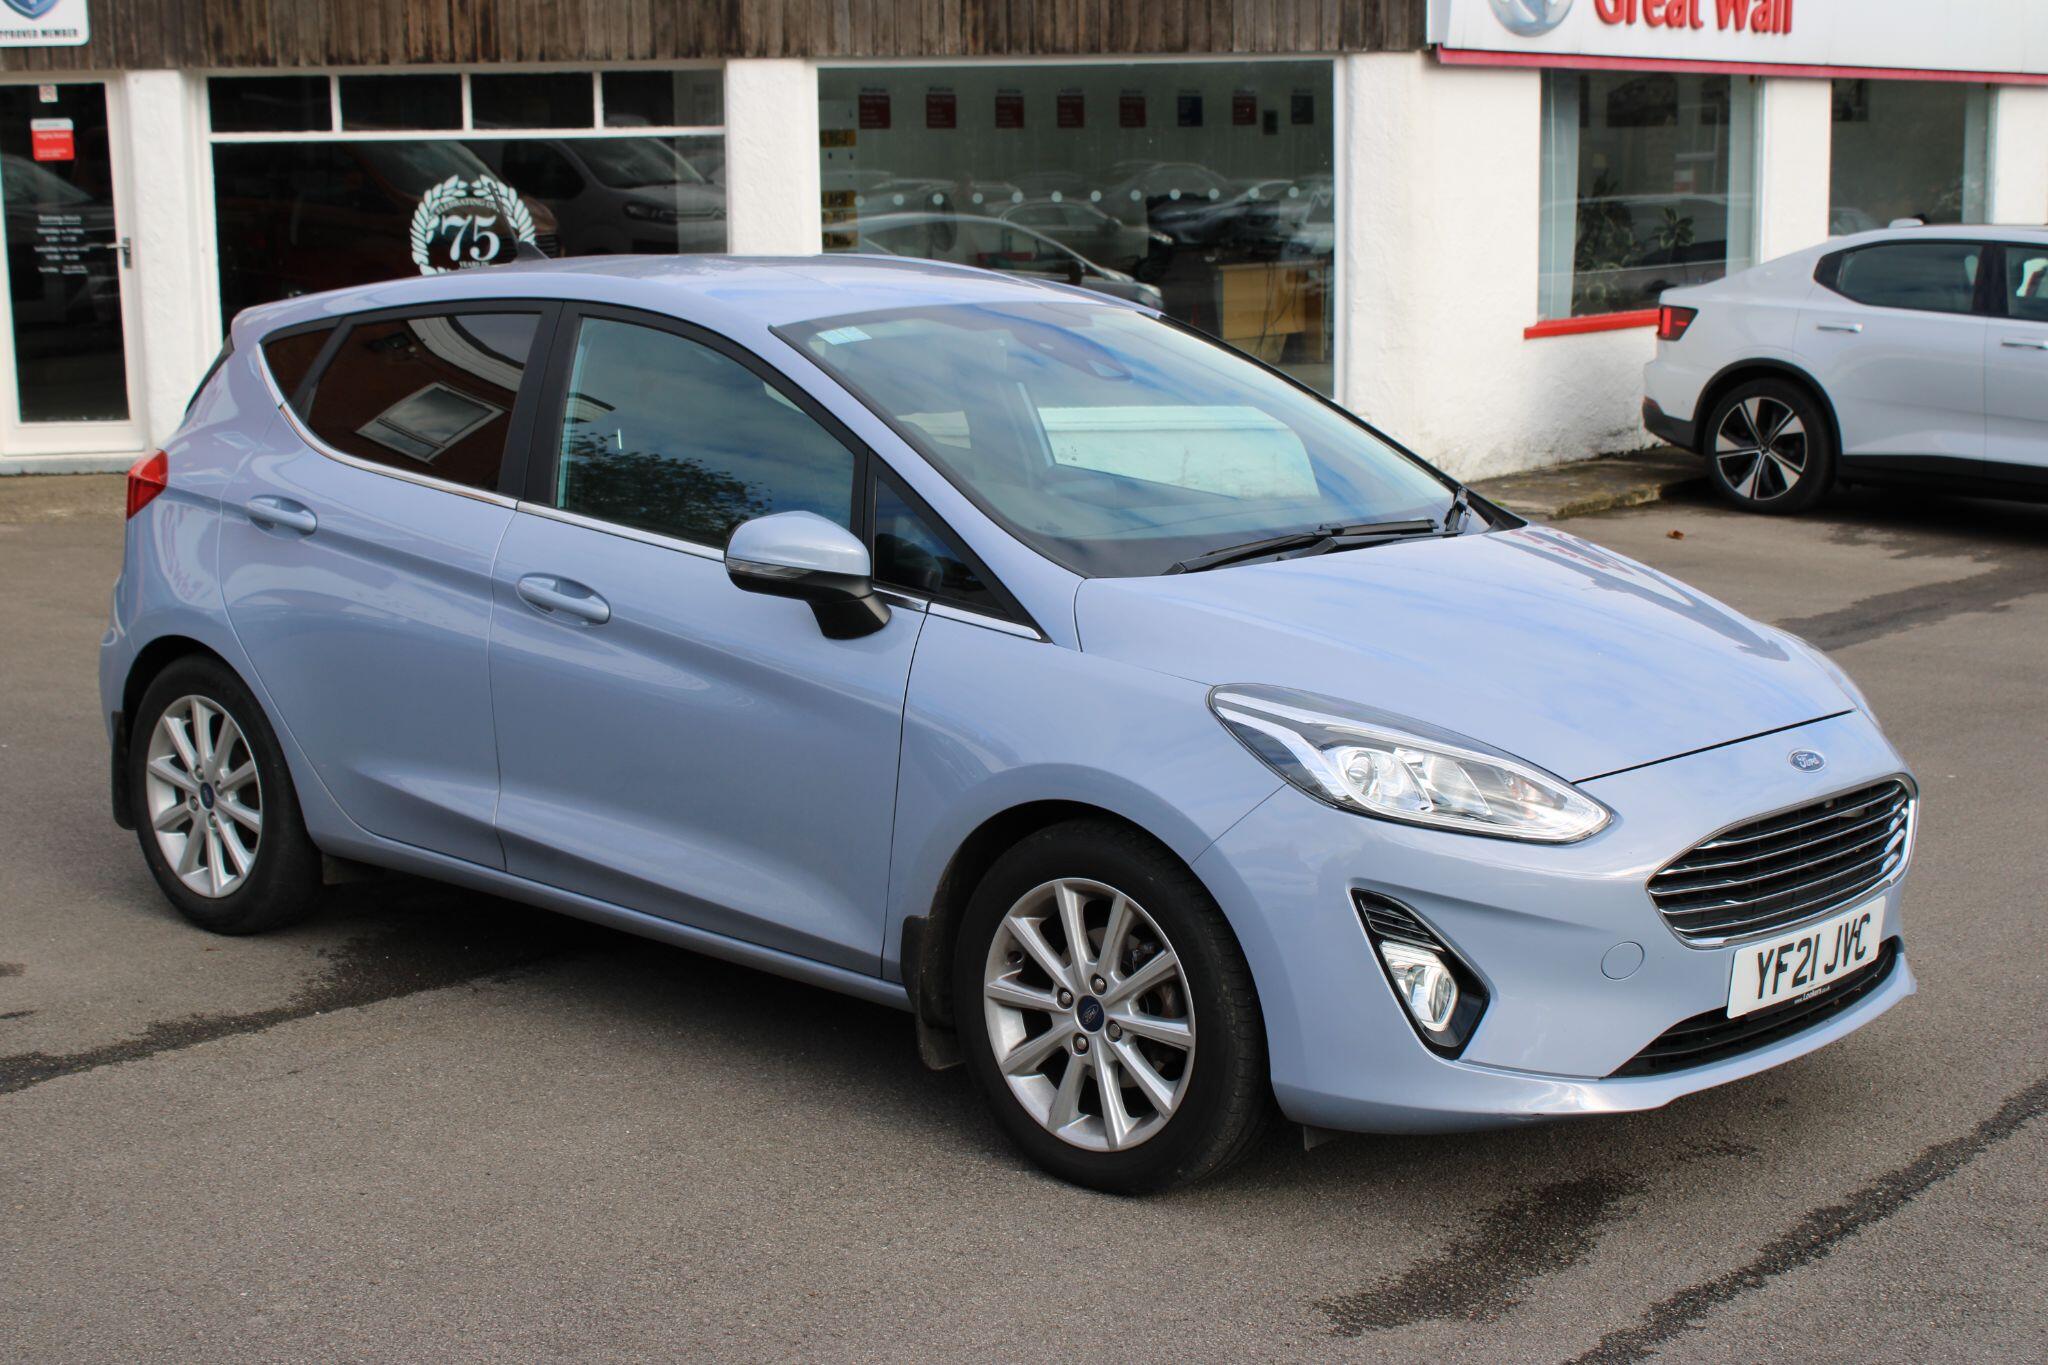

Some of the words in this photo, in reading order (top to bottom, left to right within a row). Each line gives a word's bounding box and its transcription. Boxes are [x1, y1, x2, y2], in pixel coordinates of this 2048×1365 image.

[41, 28, 78, 38] MEMBER
[1594, 0, 1704, 30] Great
[1716, 0, 1792, 34] Wall
[441, 214, 500, 262] 75
[1795, 753, 1821, 768] Ford
[1757, 933, 1821, 999] YF21
[1823, 912, 1871, 975] JVC
